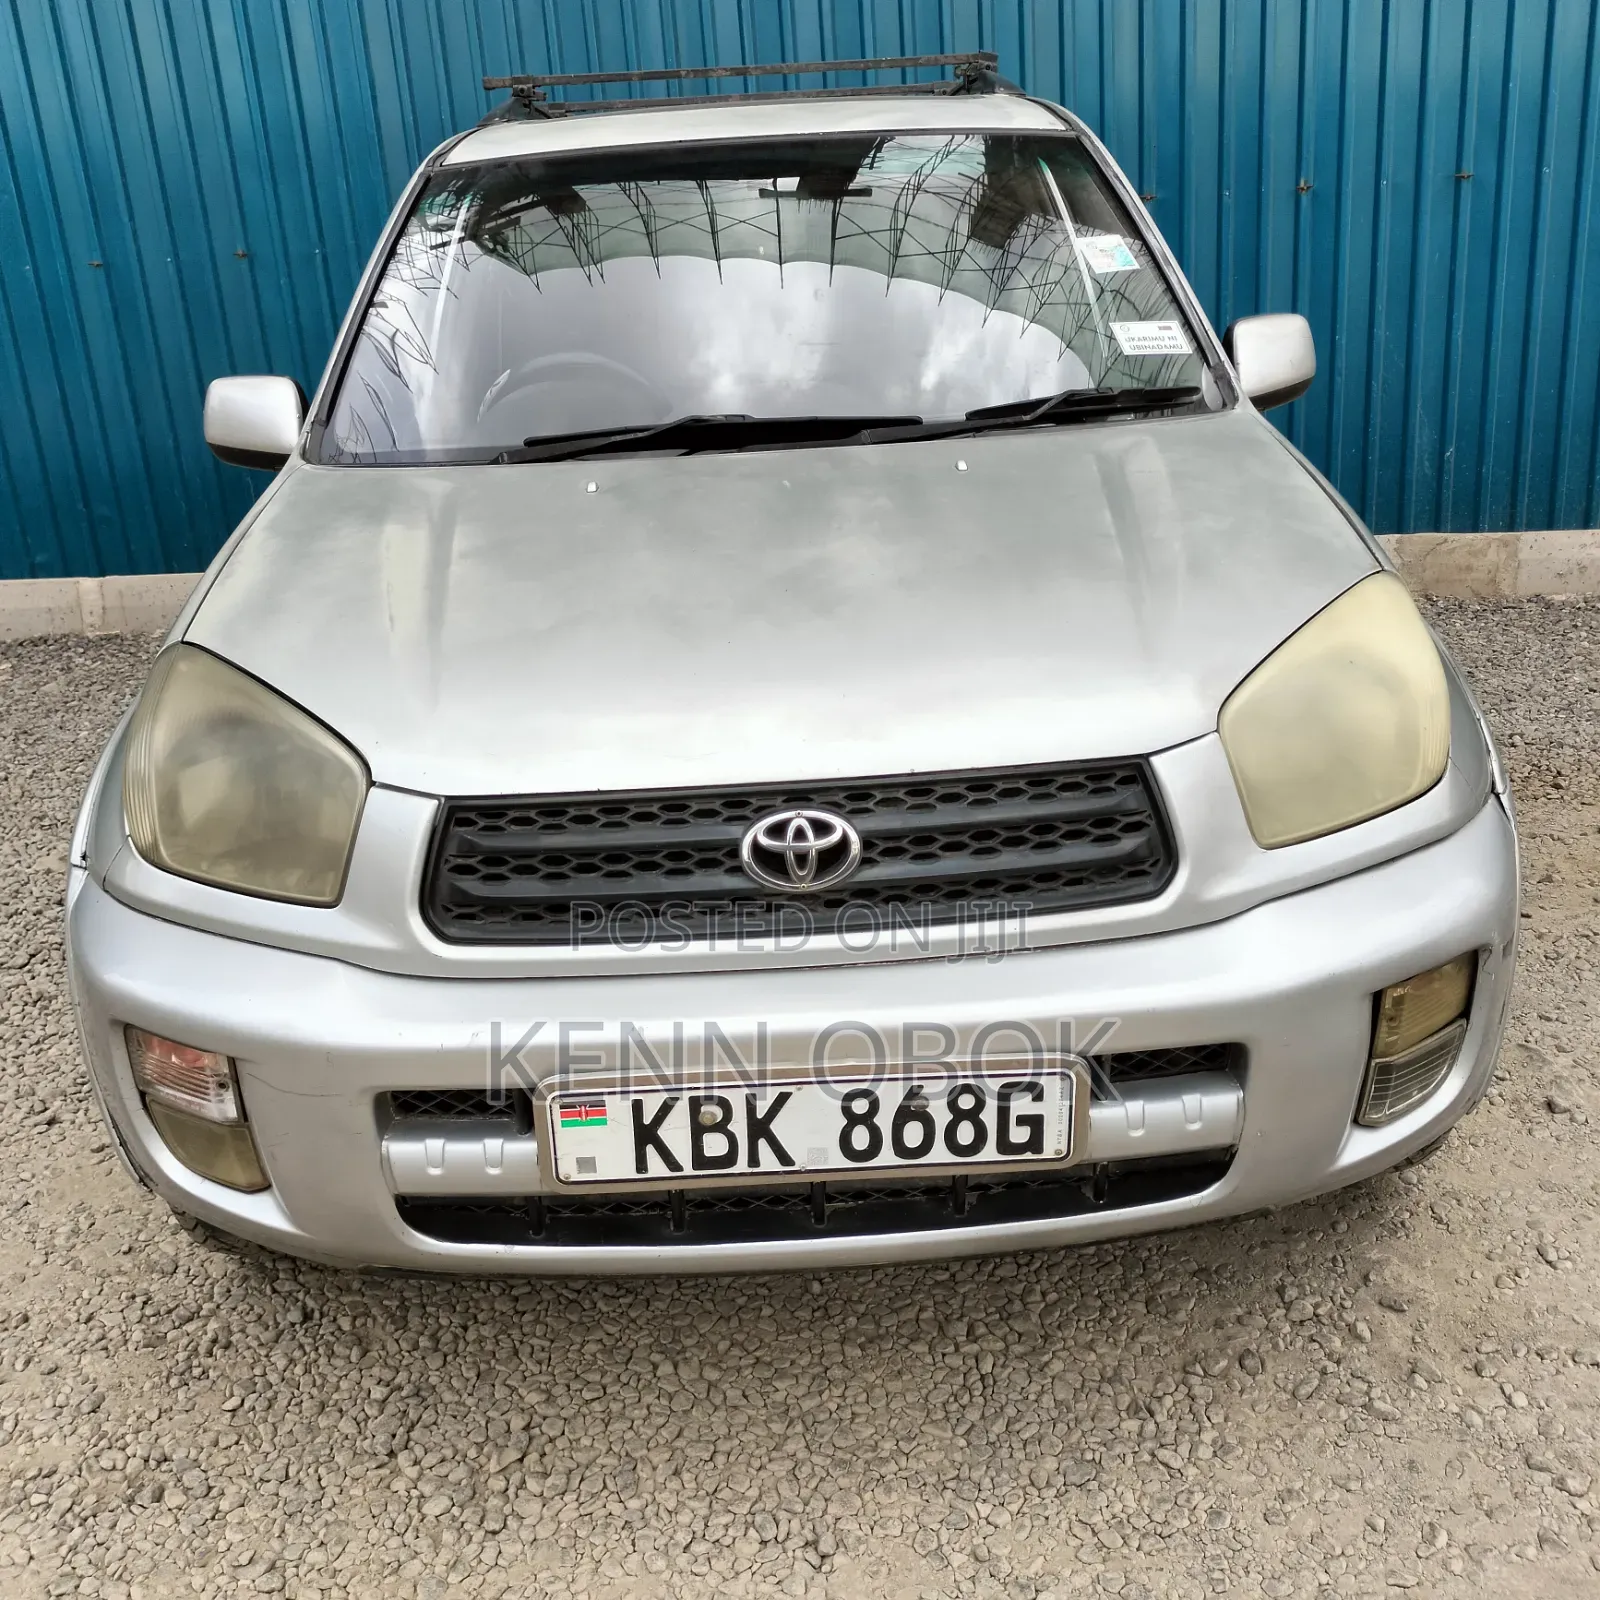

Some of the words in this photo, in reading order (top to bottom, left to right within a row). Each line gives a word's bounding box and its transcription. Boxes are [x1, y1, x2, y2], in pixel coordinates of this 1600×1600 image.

[1125, 335, 1166, 343] UKARIMU
[1129, 343, 1183, 351] UBINADAMU
[631, 1091, 796, 1174] KBK
[838, 1081, 1044, 1164] 868G
